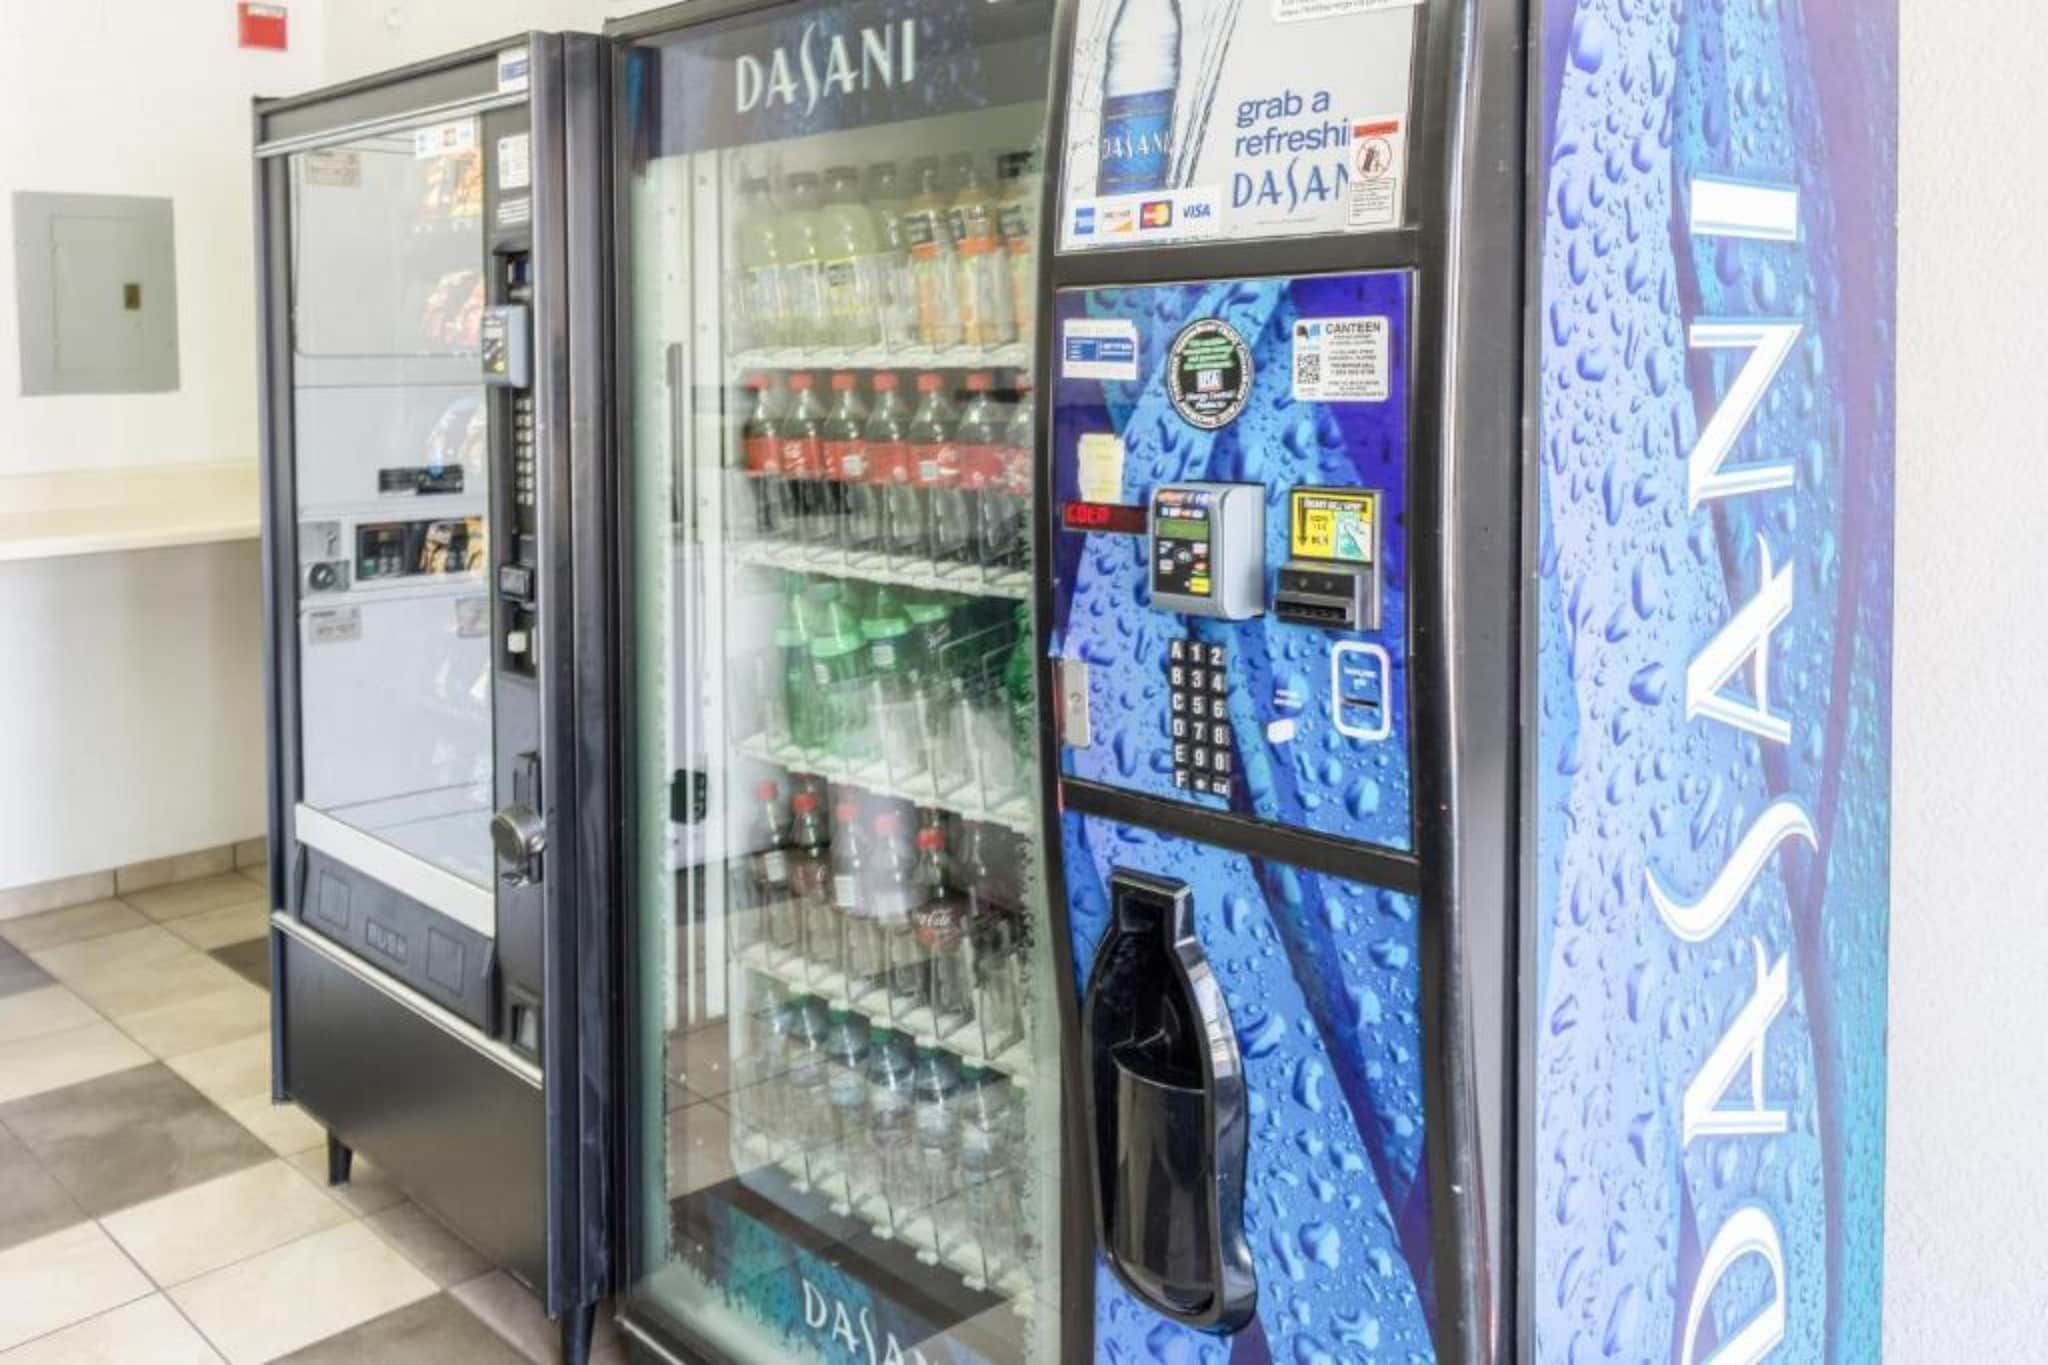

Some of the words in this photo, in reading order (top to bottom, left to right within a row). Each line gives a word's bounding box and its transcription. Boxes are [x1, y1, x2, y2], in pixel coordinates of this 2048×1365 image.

[736, 19, 916, 117] DASANI
[1236, 89, 1303, 128] grab
[1311, 90, 1331, 113] a
[1235, 118, 1351, 157] refreshi
[1183, 204, 1211, 218] VISA
[1326, 322, 1381, 334] CANTEEN
[1171, 640, 1182, 659] A
[1190, 644, 1200, 662] 1
[1211, 647, 1223, 666] 2
[1171, 666, 1182, 685] B
[1192, 670, 1202, 688] 3
[1212, 673, 1224, 691] 4
[1173, 692, 1184, 711] C
[1192, 696, 1202, 715] 5
[1213, 700, 1224, 719] 6
[1193, 722, 1203, 740] 7
[1215, 727, 1224, 744] 8
[1175, 744, 1186, 762] E
[1195, 748, 1204, 766] 9
[1176, 770, 1186, 788] F
[1645, 177, 1818, 1365] DASANI
